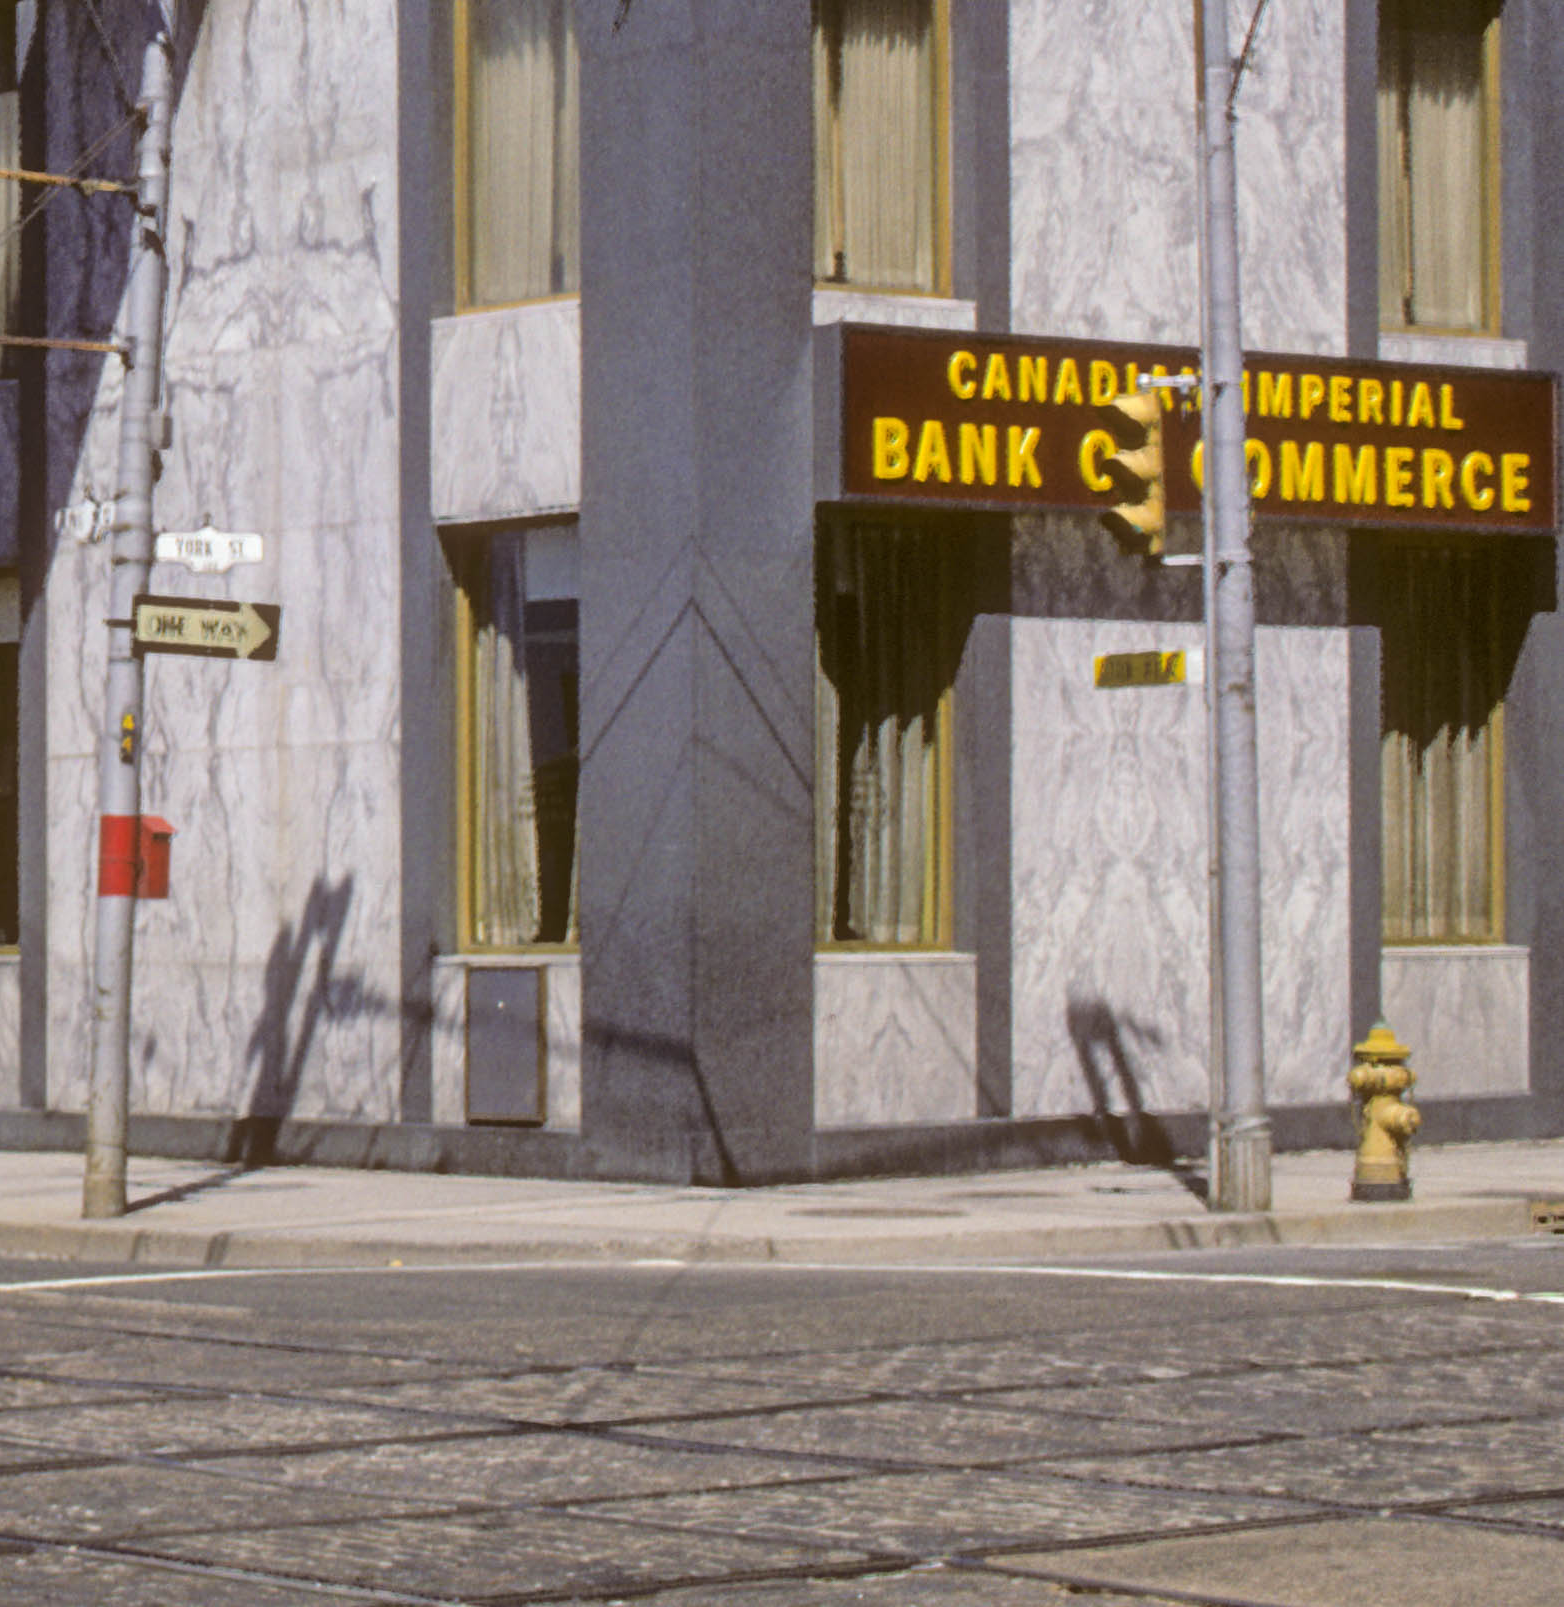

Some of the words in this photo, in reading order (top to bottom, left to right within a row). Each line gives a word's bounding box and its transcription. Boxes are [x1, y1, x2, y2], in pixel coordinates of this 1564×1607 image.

[1241, 370, 1464, 430] IMPERIAL
[873, 417, 1042, 488] BANK
[176, 537, 212, 556] YORK
[201, 616, 248, 641] WAY
